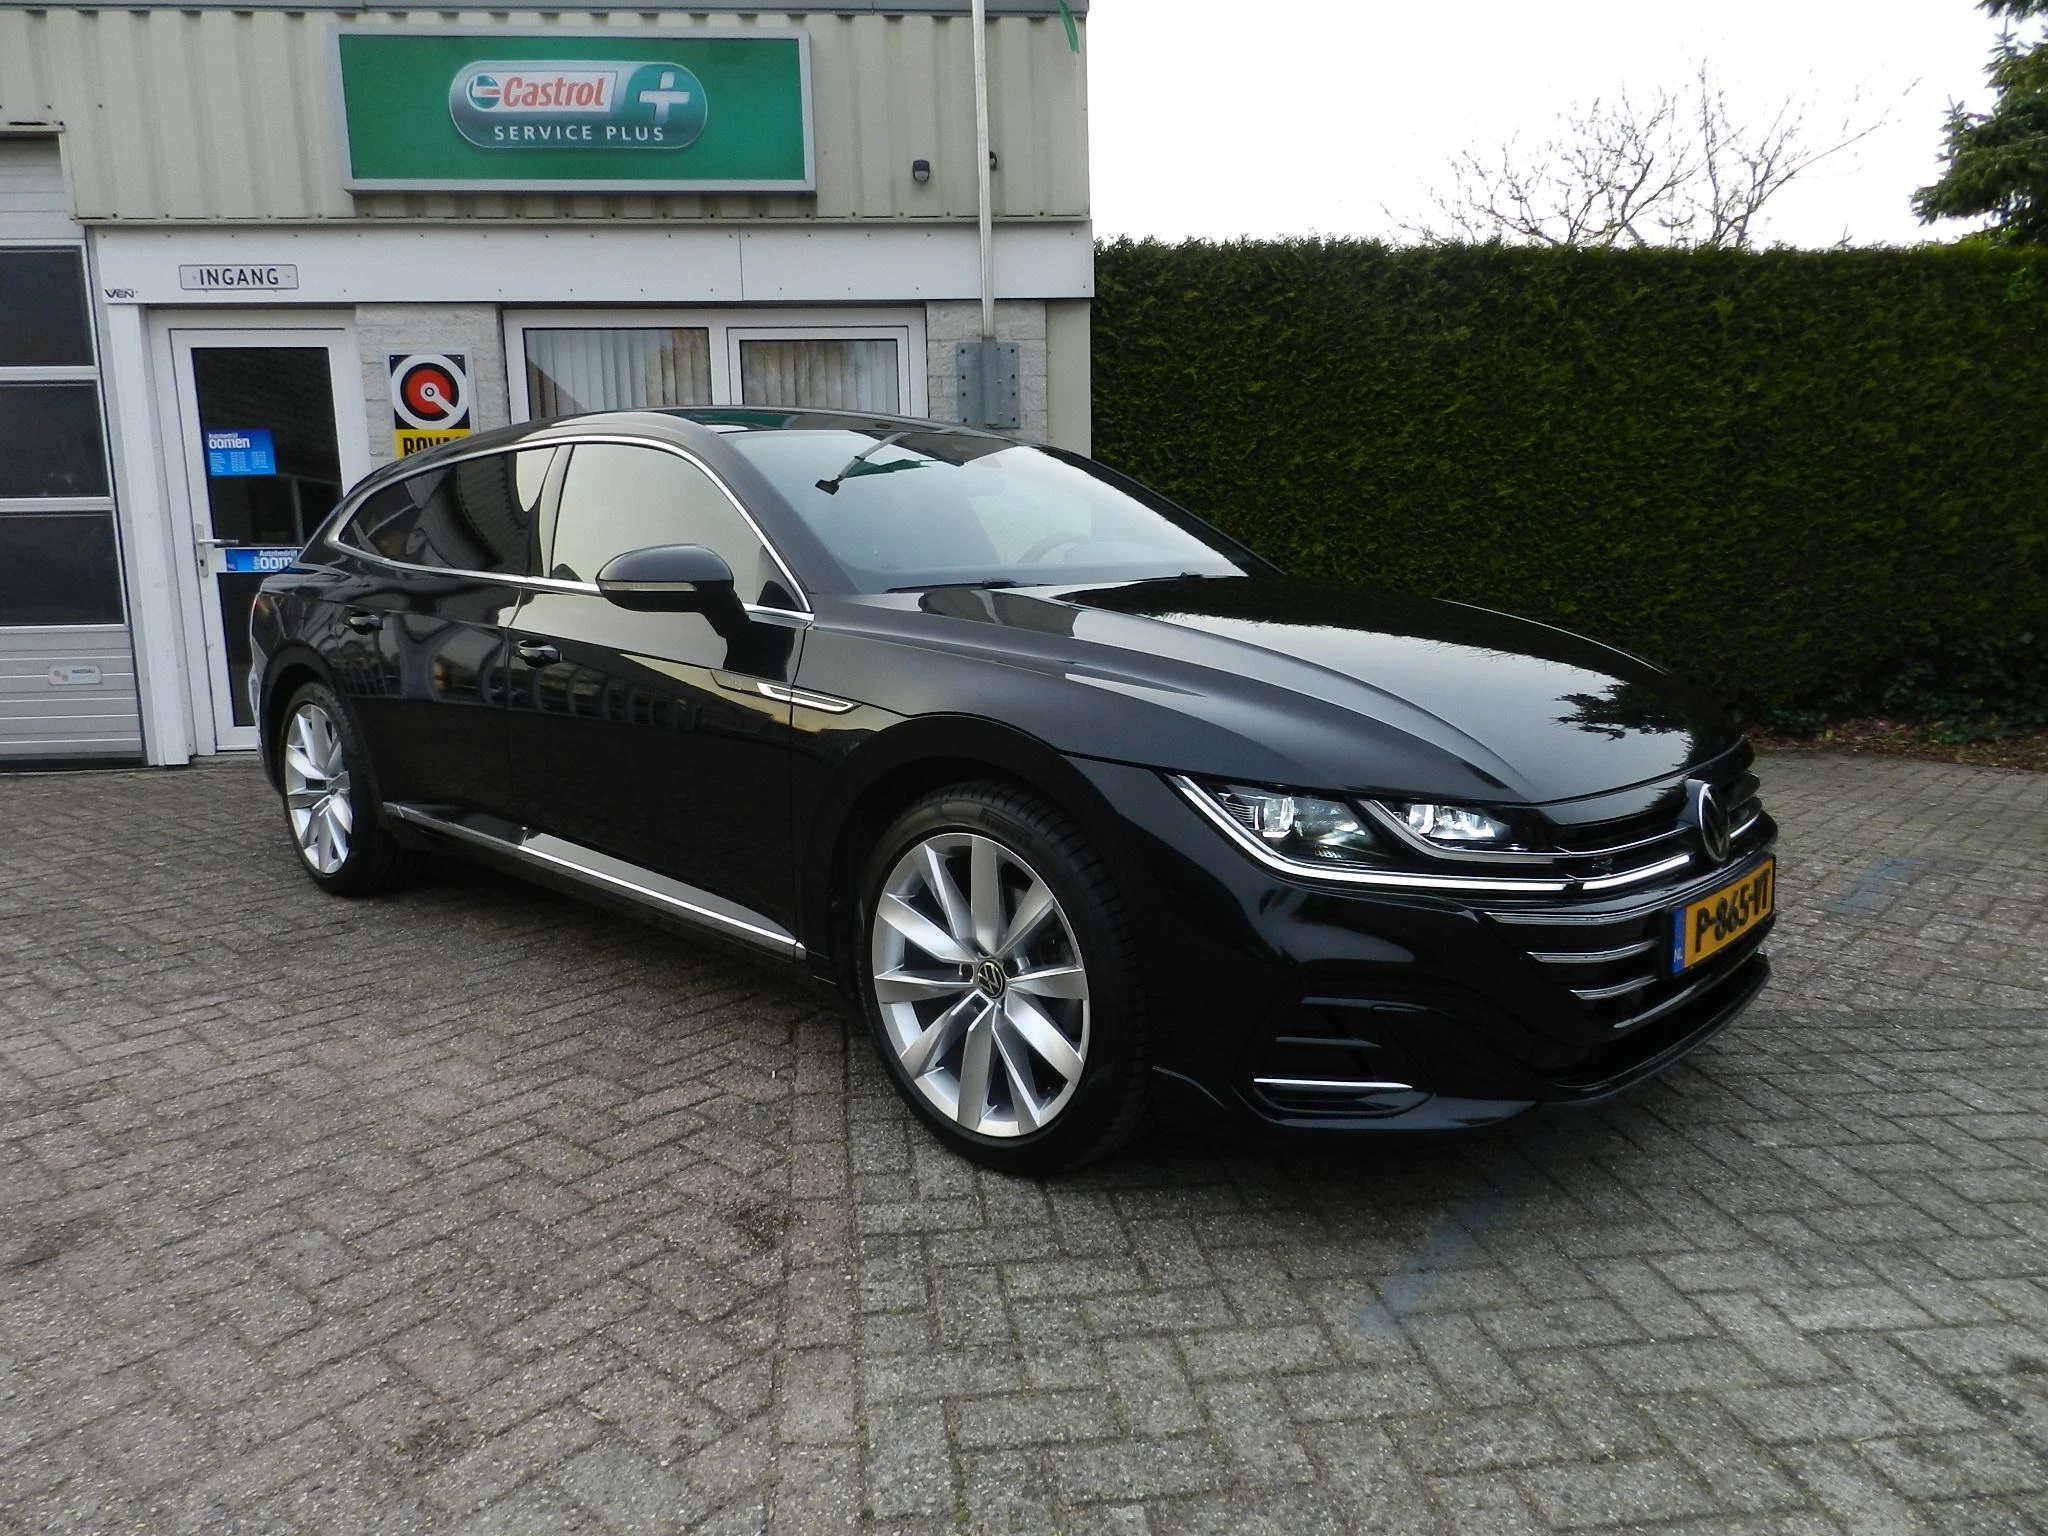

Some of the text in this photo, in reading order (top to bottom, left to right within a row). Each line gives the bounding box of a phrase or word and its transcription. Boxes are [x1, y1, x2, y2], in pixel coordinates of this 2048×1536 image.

[503, 77, 605, 107] Castrol
[494, 125, 664, 141] SERVICE PLUS
[199, 268, 279, 286] INGANG
[209, 438, 251, 449] oomen
